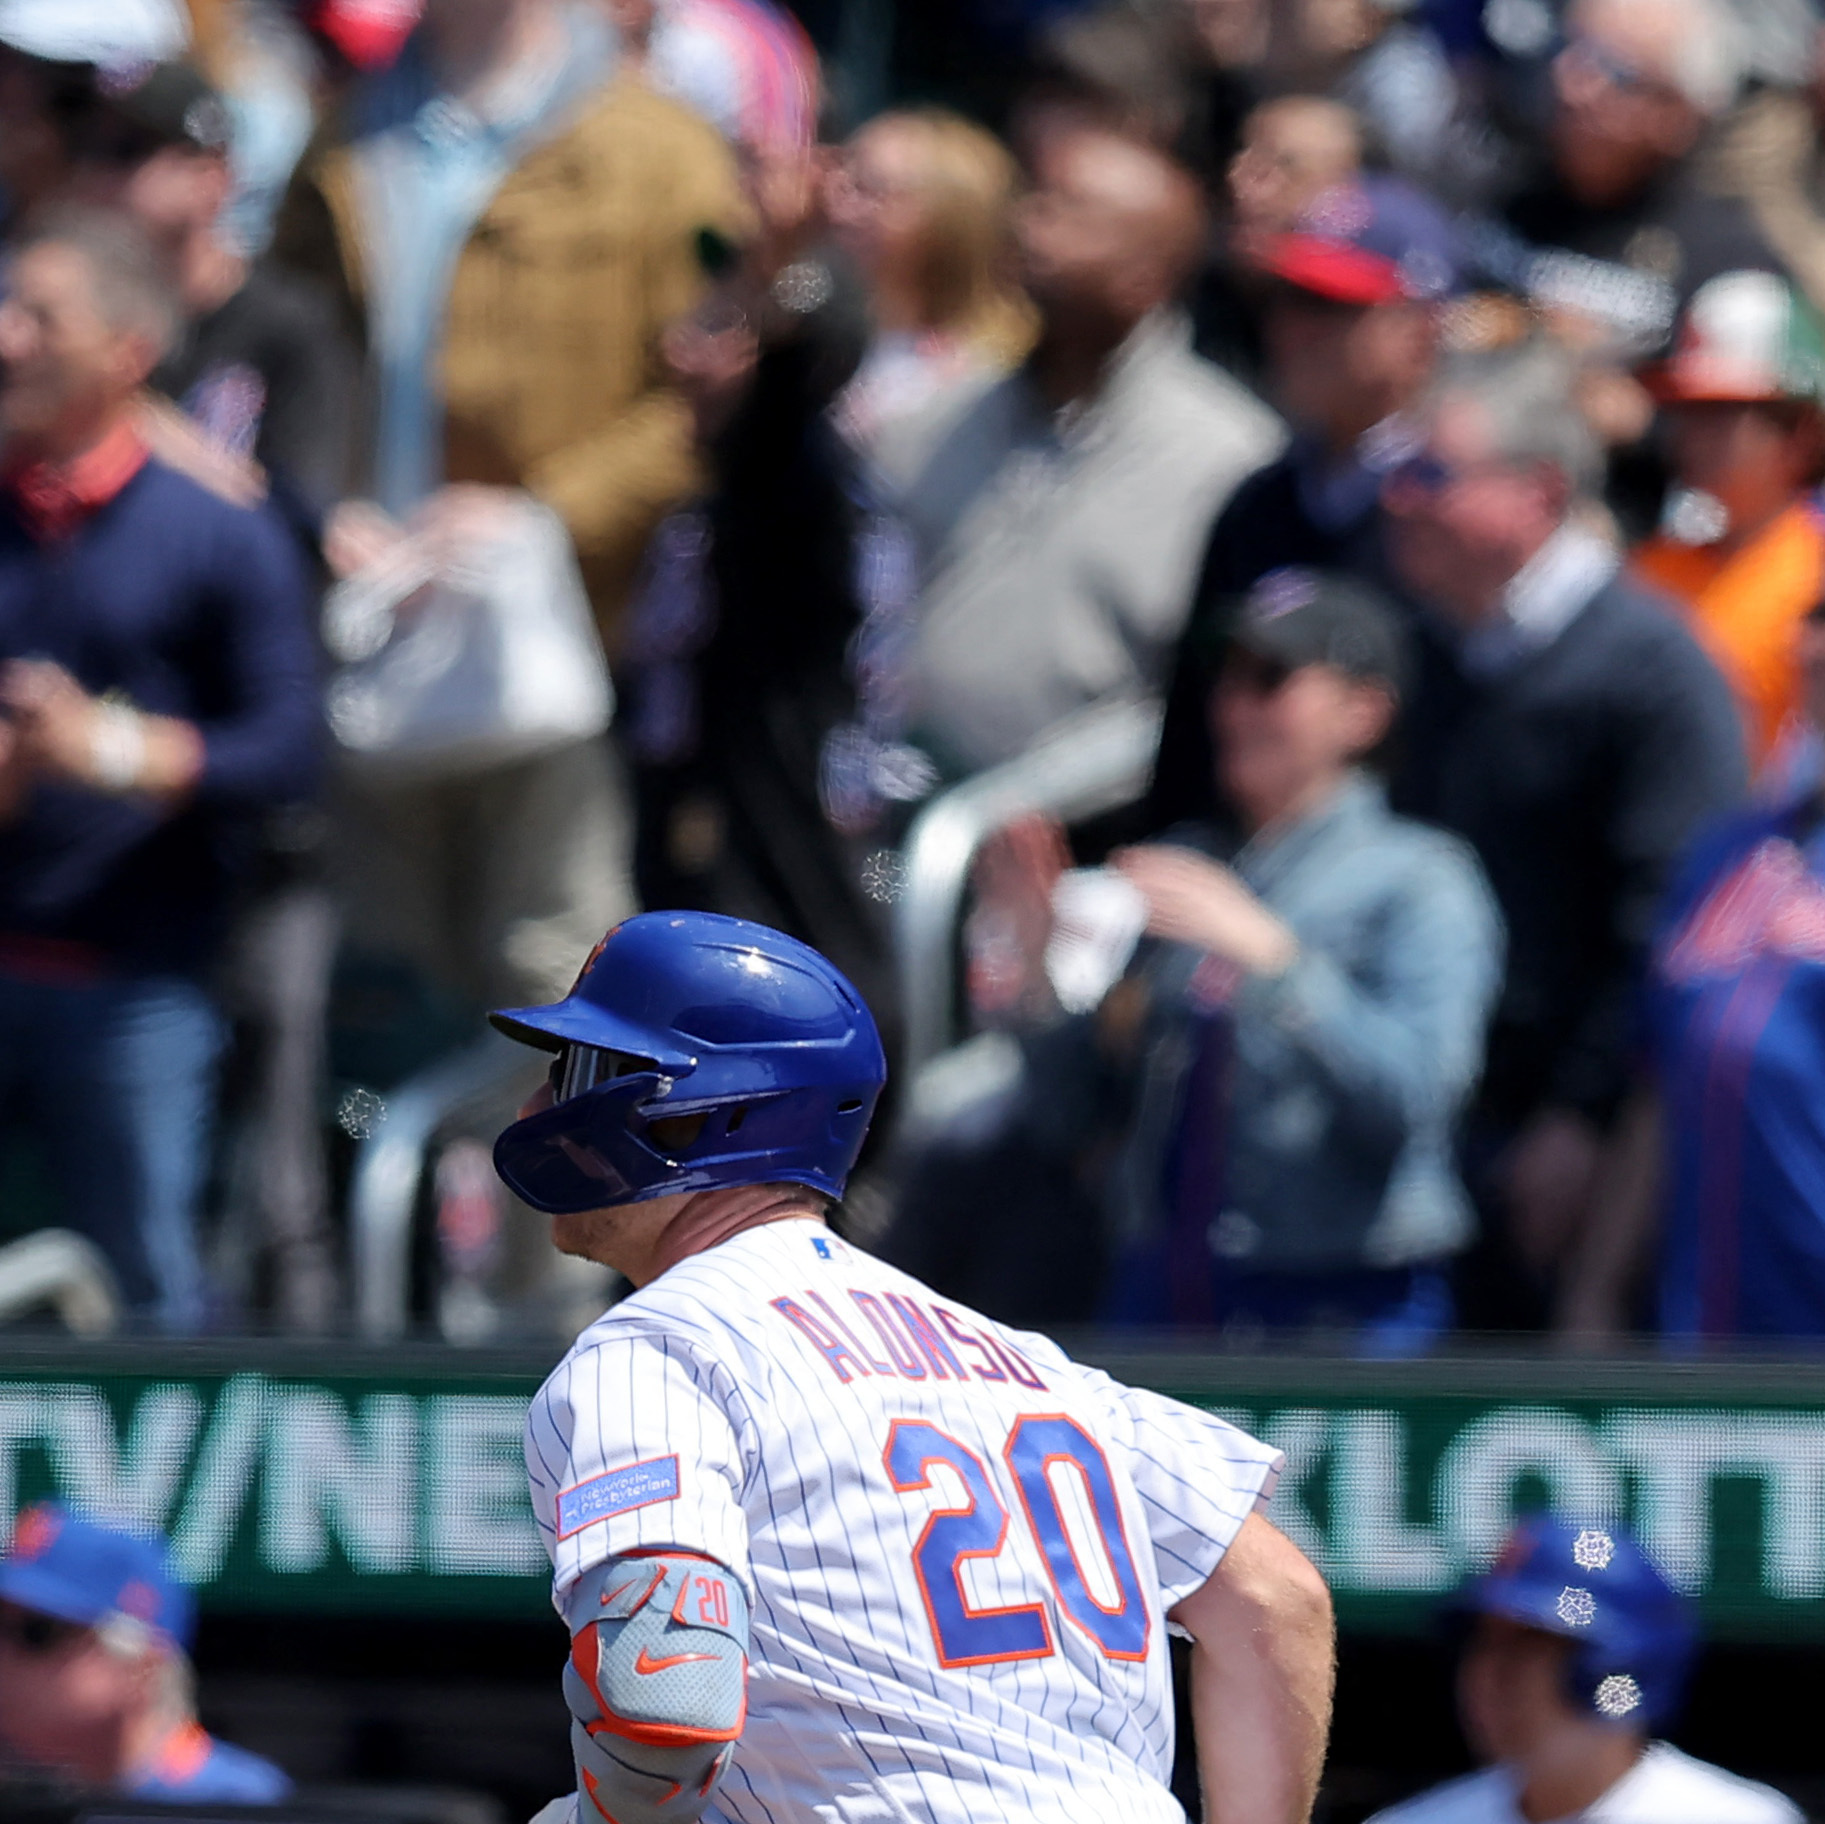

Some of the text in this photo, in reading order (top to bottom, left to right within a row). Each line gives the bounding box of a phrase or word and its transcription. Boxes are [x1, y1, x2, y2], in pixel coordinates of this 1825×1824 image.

[768, 1288, 1050, 1392] ALONSO
[580, 1478, 672, 1515] Presbyterian
[882, 1413, 1151, 1669] 20
[694, 1576, 729, 1627] 20
